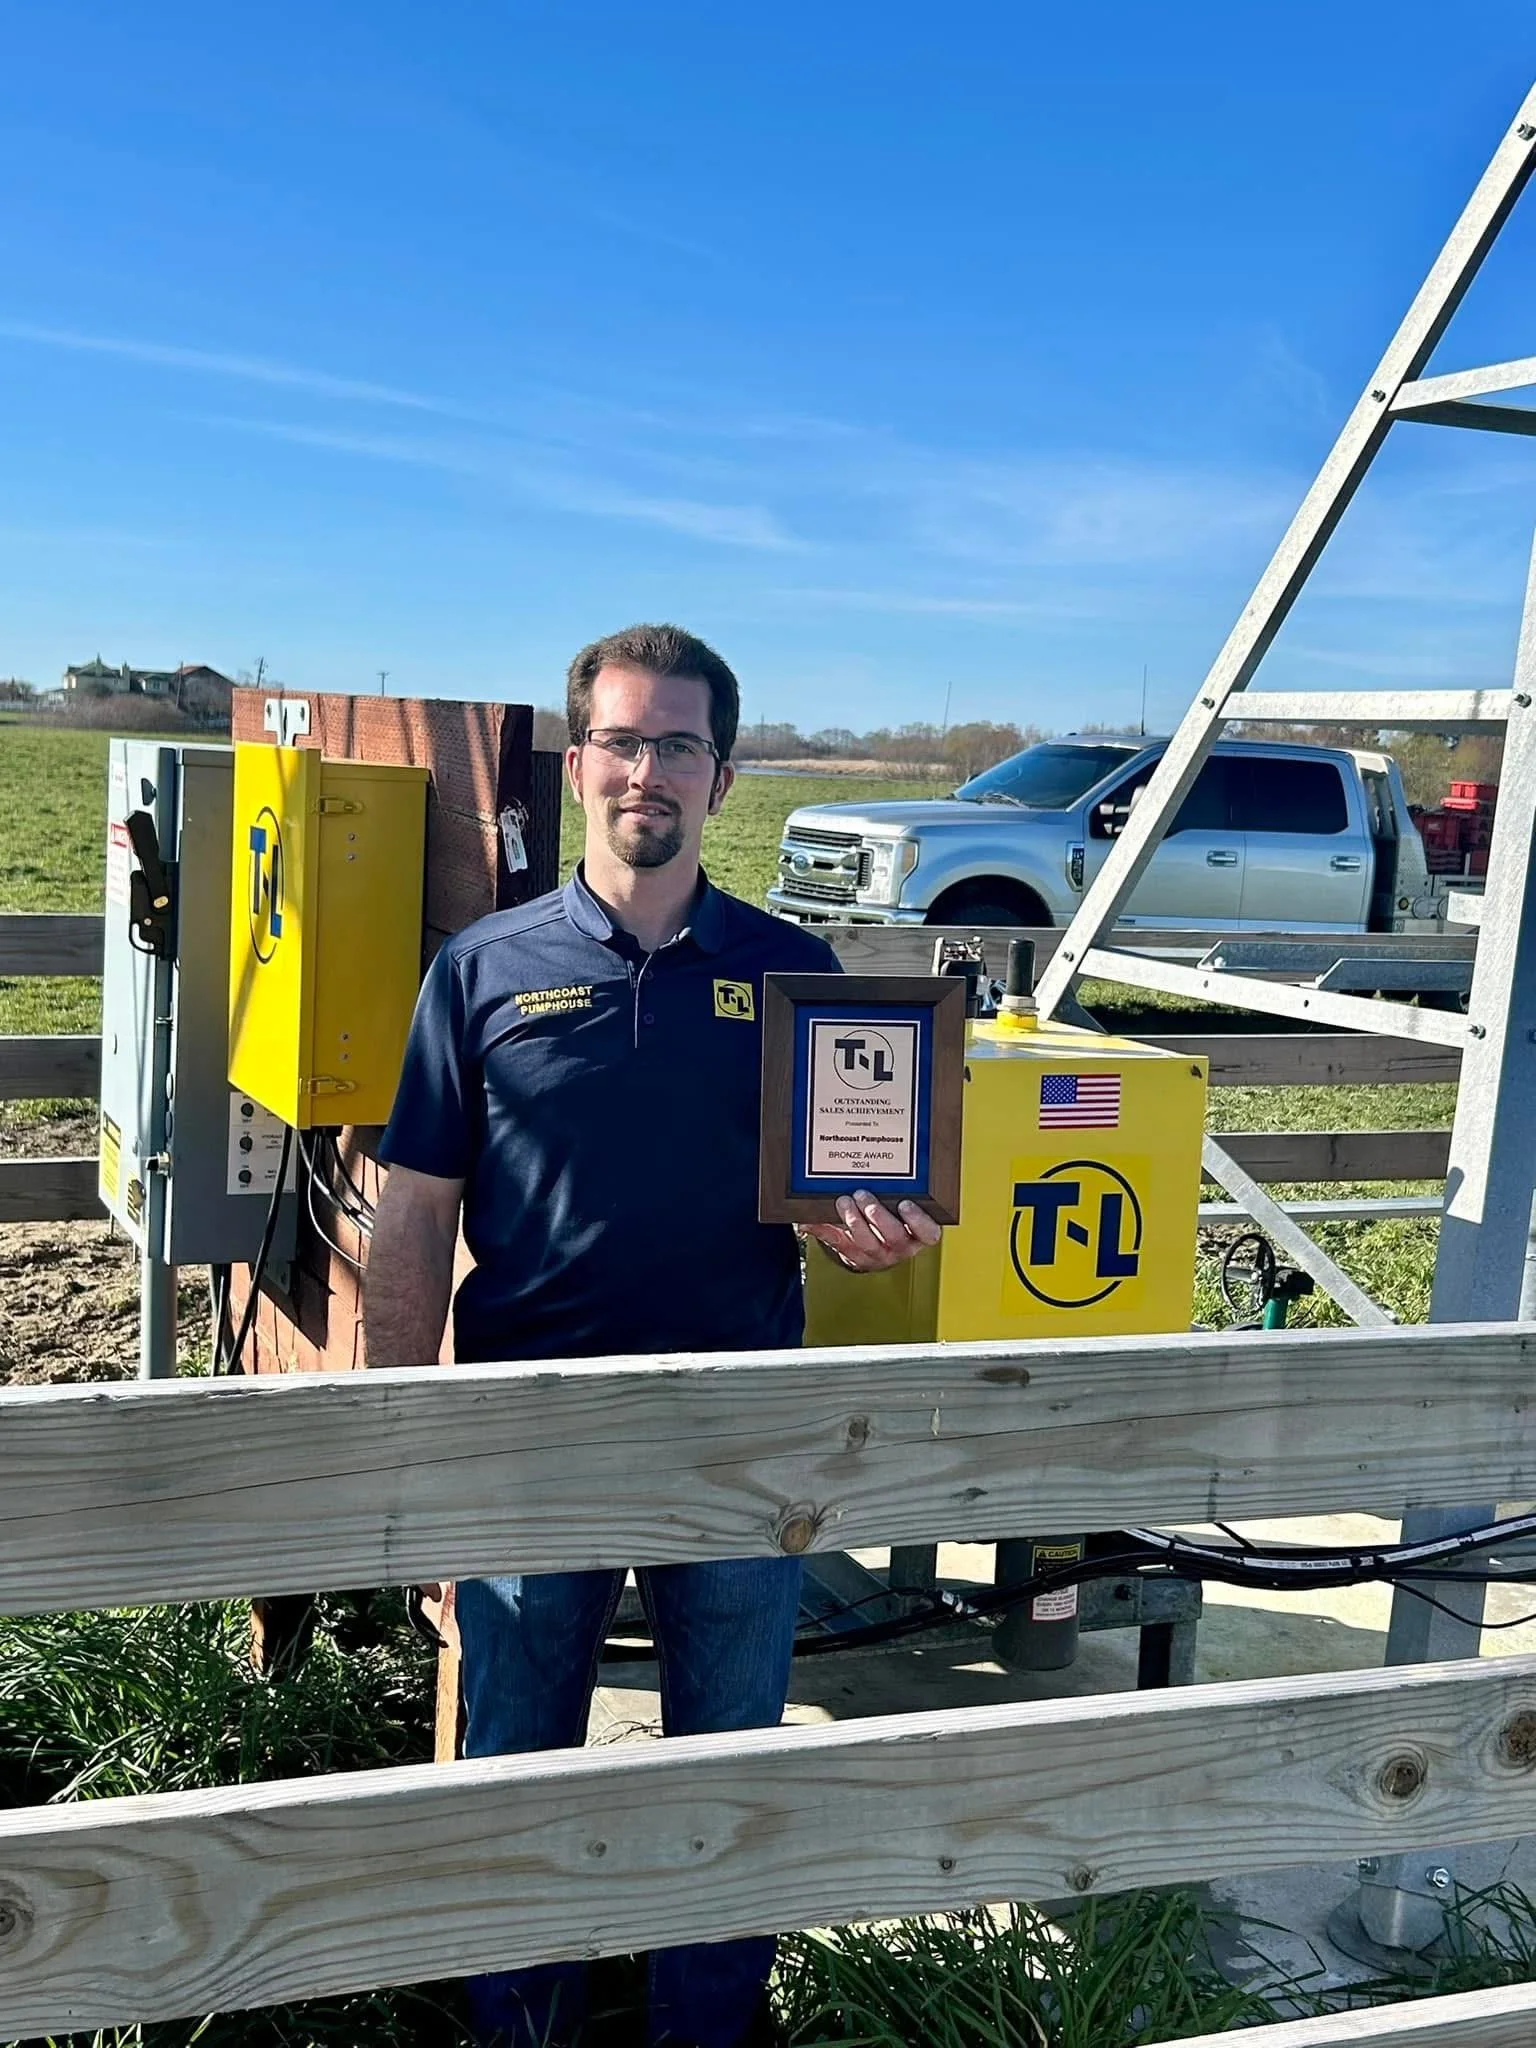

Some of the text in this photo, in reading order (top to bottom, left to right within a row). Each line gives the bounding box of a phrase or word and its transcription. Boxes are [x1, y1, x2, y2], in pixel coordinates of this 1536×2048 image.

[515, 986, 592, 1005] NORTHCOAST
[520, 999, 592, 1015] PUMPHOUSE
[834, 1098, 891, 1106] OUTSTANDING
[819, 1107, 904, 1116] SALES ACHIEVEMENT
[819, 1134, 904, 1144] Northcoast Pumphouse
[828, 1151, 894, 1160] BRONZE AWARD
[851, 1161, 870, 1169] 2024
